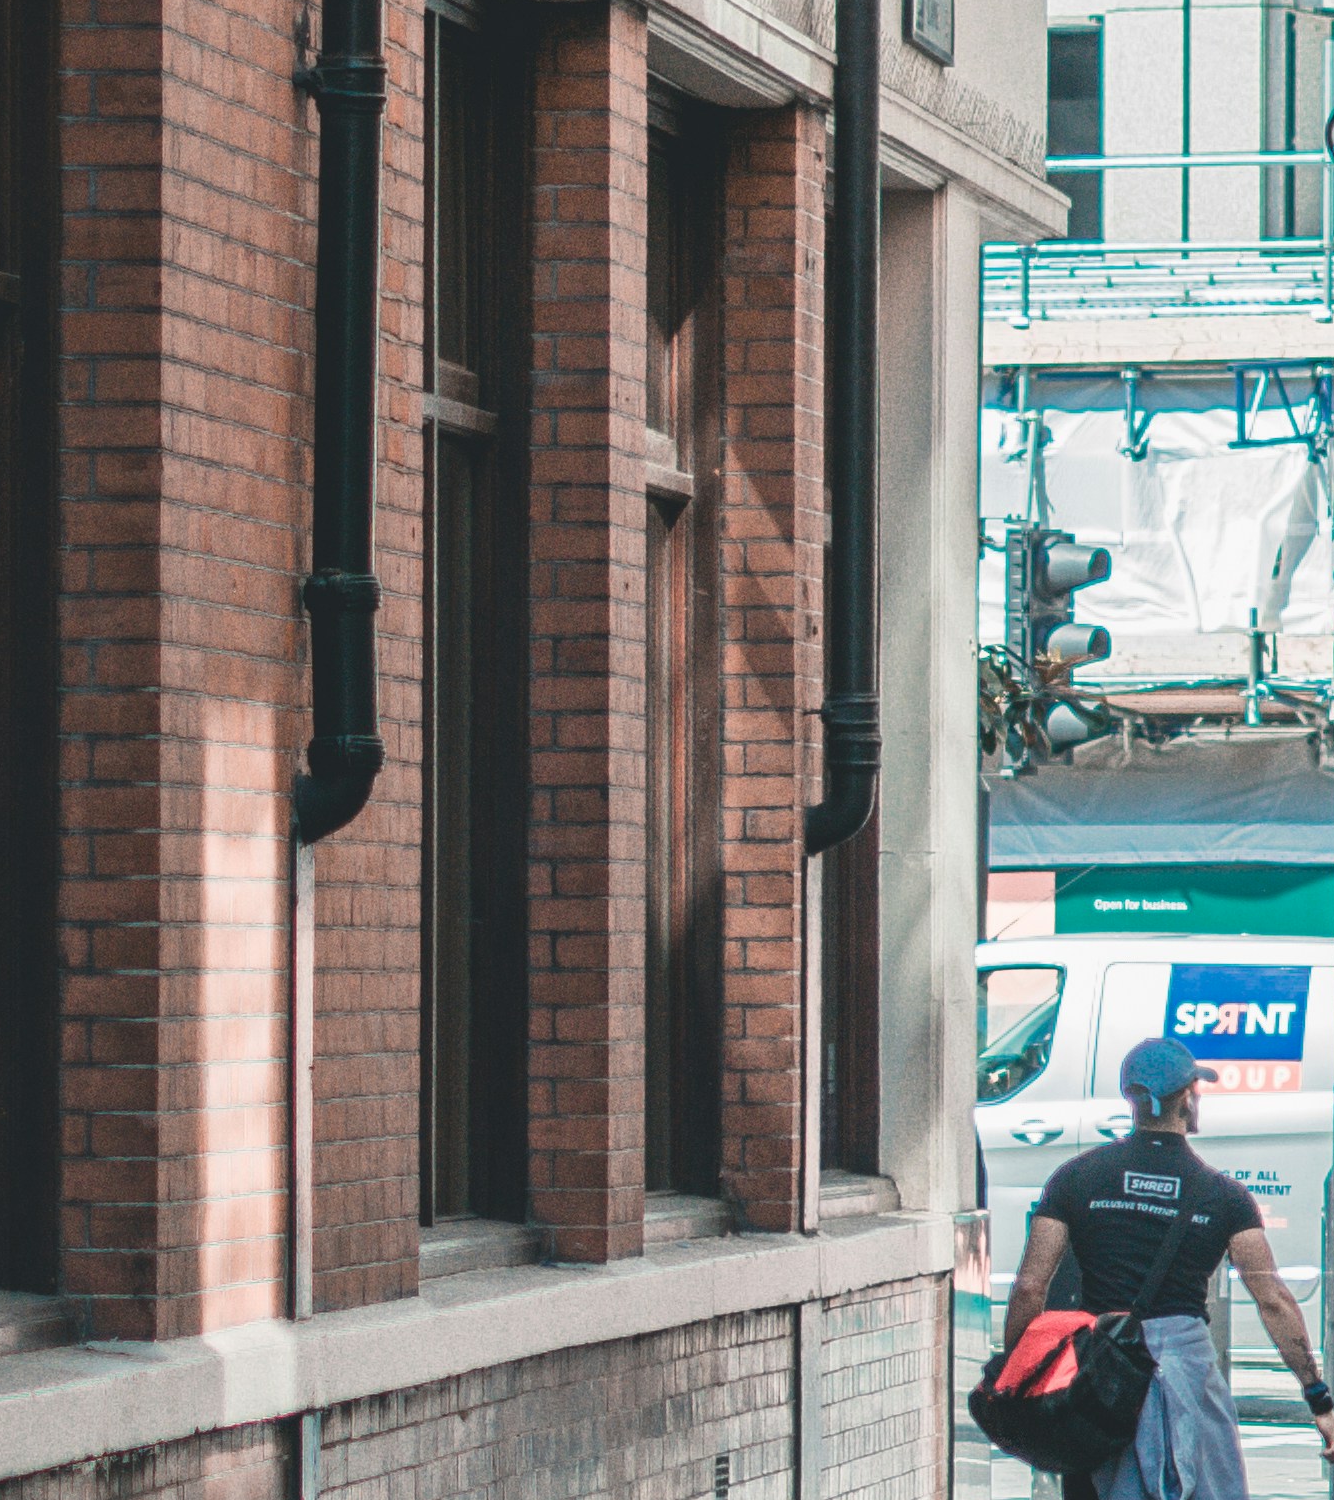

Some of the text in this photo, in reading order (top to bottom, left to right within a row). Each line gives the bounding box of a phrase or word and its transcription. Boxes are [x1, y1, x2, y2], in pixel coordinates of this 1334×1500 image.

[1094, 899, 1123, 912] Open
[1125, 899, 1140, 910] for
[1220, 1064, 1291, 1090] OUP
[1235, 1171, 1251, 1181] OF
[1257, 1171, 1279, 1181] ALL
[1130, 1179, 1174, 1193] SHRED
[1247, 1185, 1292, 1196] PMENT
[1089, 1200, 1136, 1210] EXCLUSIVE
[1137, 1202, 1148, 1211] TO
